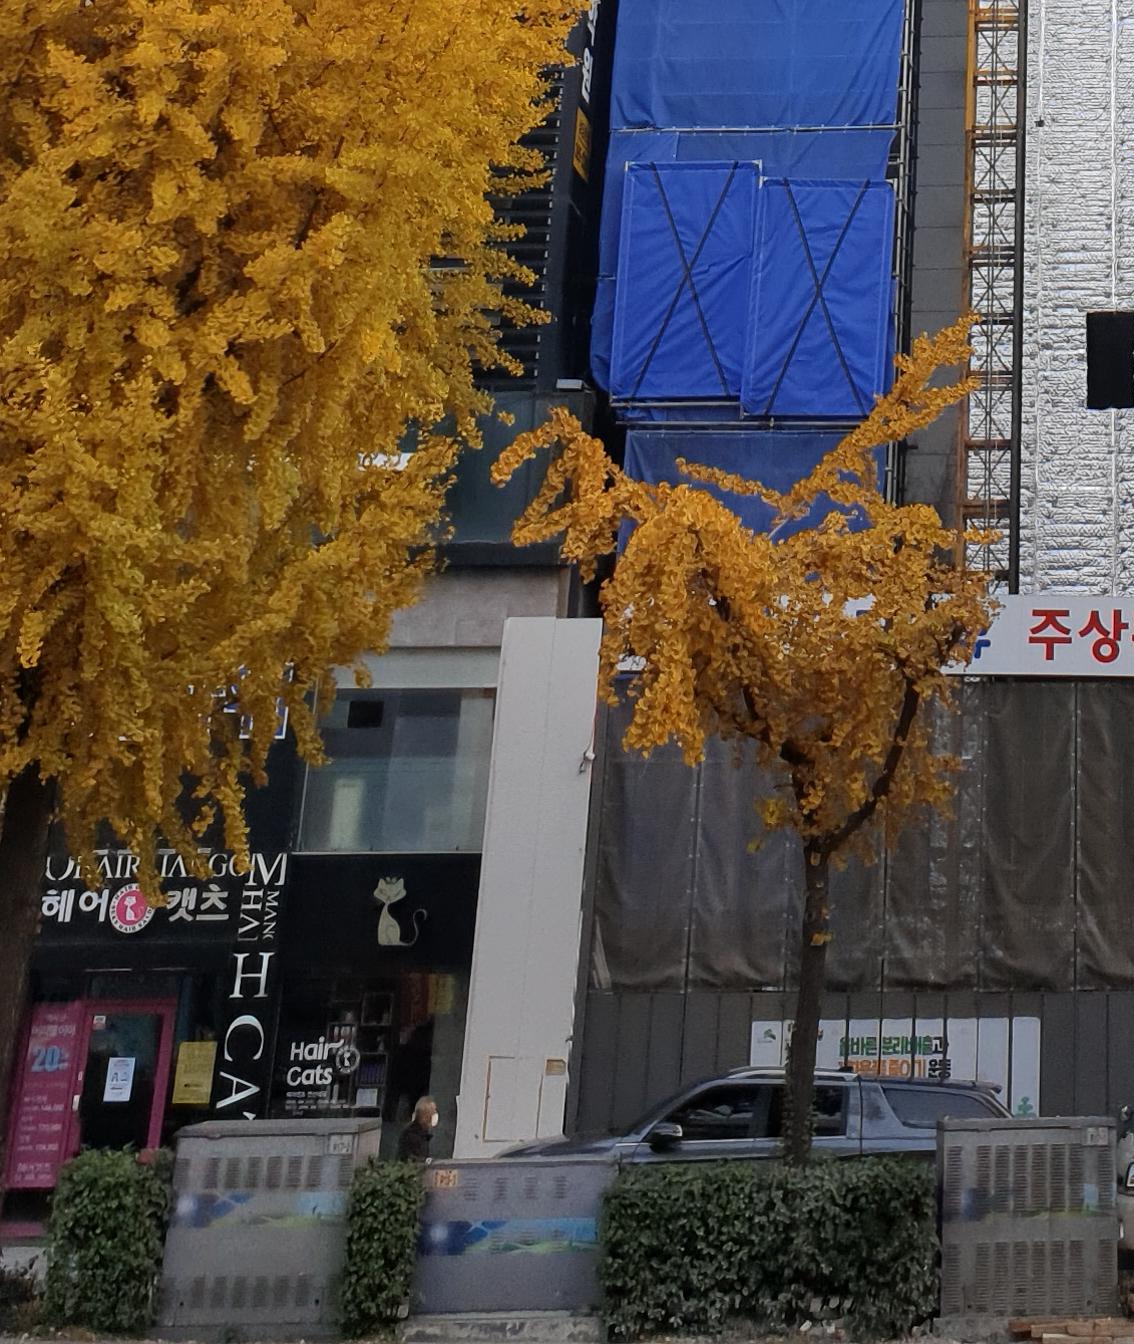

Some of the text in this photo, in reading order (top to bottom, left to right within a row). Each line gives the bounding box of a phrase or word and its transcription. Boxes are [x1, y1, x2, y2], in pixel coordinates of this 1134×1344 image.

[41, 887, 110, 923] 헤어
[165, 883, 230, 922] 캣츠
[290, 1035, 344, 1062] Hair
[286, 1064, 333, 1087] Cats
